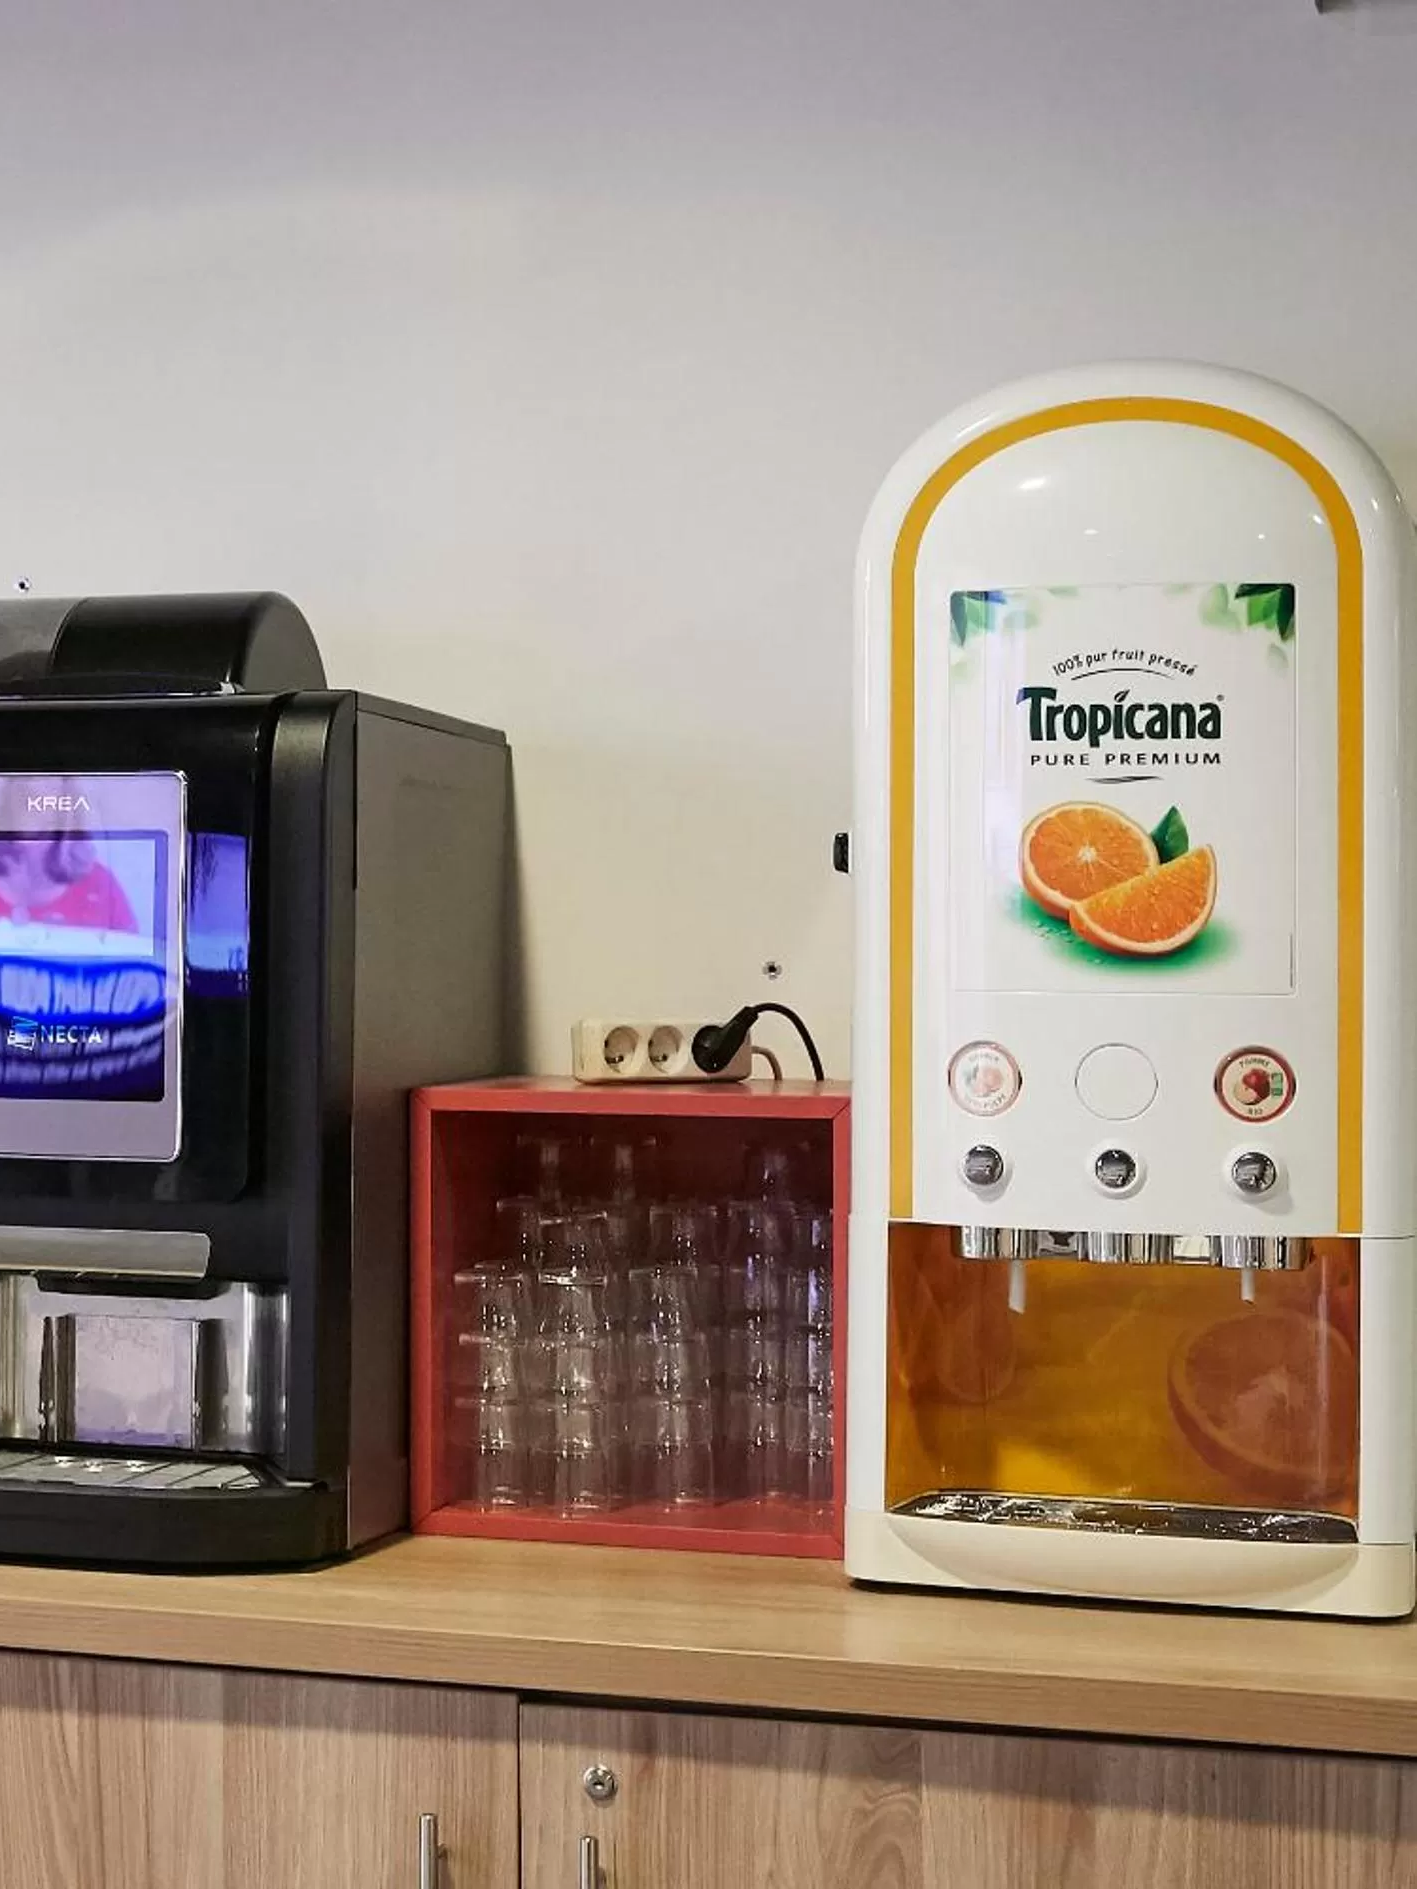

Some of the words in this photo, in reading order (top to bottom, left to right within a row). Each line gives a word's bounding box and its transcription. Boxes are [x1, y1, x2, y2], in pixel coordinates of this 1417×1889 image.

[1052, 655, 1083, 677] 100%
[1085, 651, 1107, 667] pur
[1112, 648, 1145, 661] fruit
[1149, 653, 1199, 677] pressé
[1016, 686, 1222, 748] Tropicana
[1030, 753, 1090, 766] PURE
[1104, 752, 1221, 766] PREMIUM
[27, 796, 90, 812] KREA
[40, 1025, 103, 1044] NECTA
